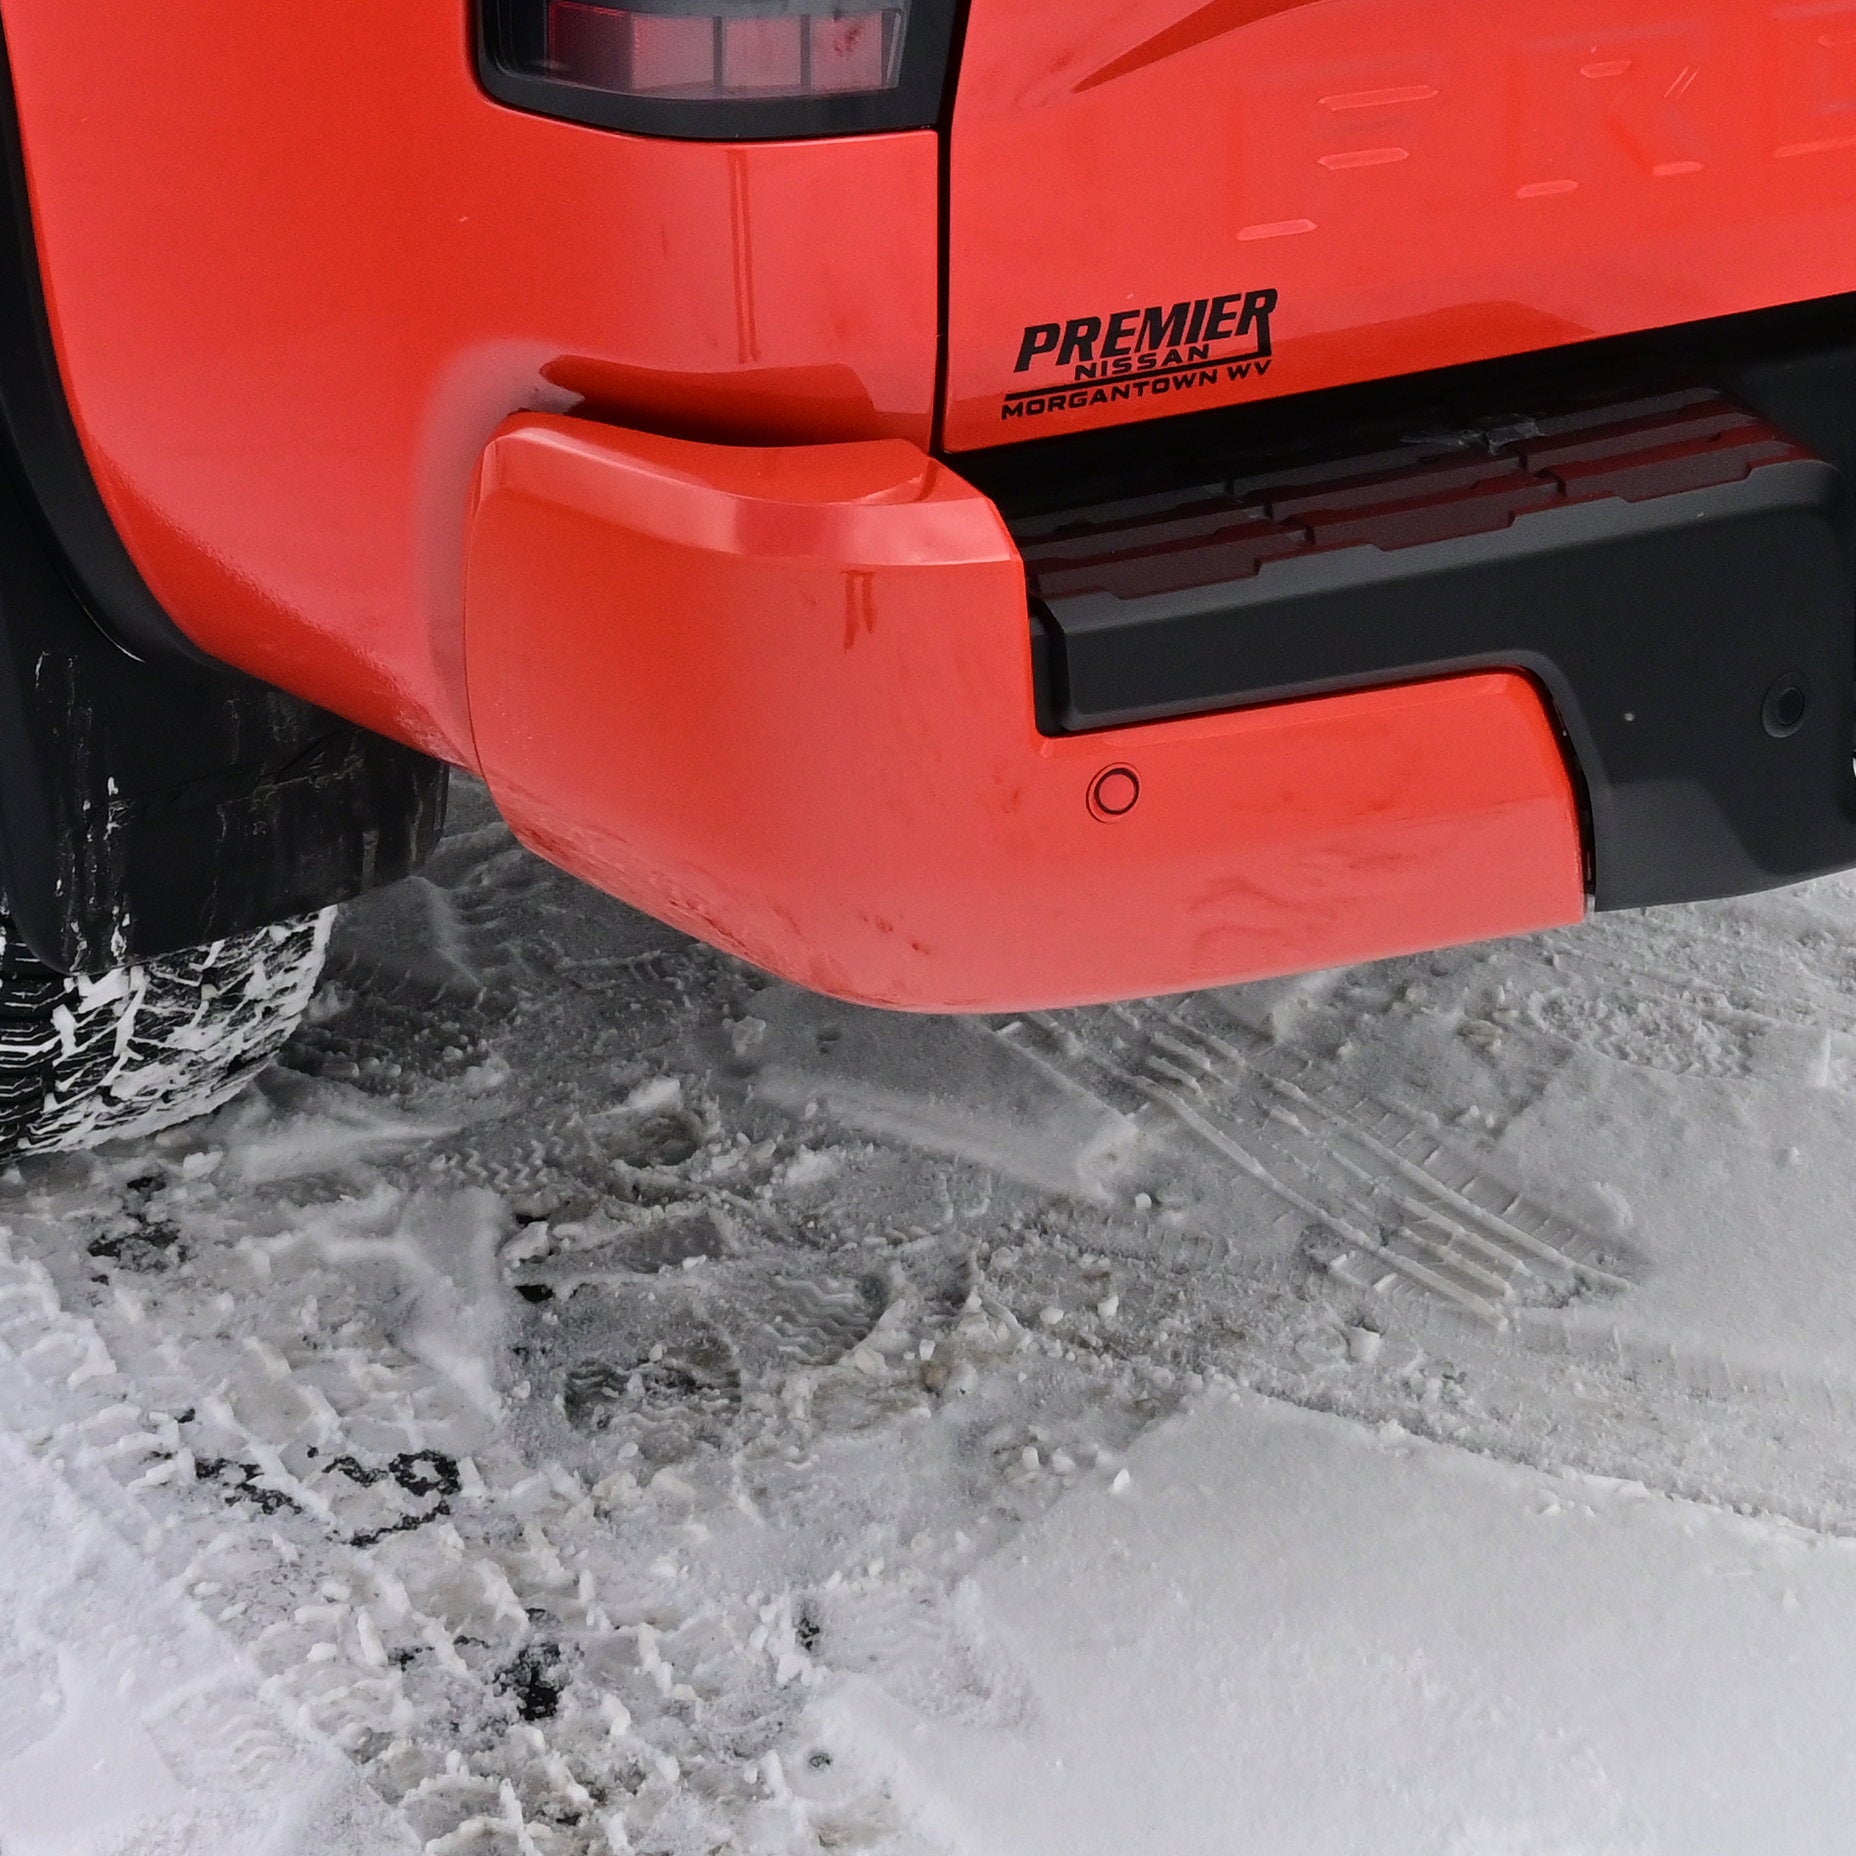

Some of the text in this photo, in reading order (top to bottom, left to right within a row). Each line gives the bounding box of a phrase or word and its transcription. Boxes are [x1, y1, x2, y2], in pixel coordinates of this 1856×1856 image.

[1014, 288, 1278, 373] PREMIER
[1001, 359, 1272, 420] MORGANTOWN WV
[1074, 344, 1210, 381] NISSAN
